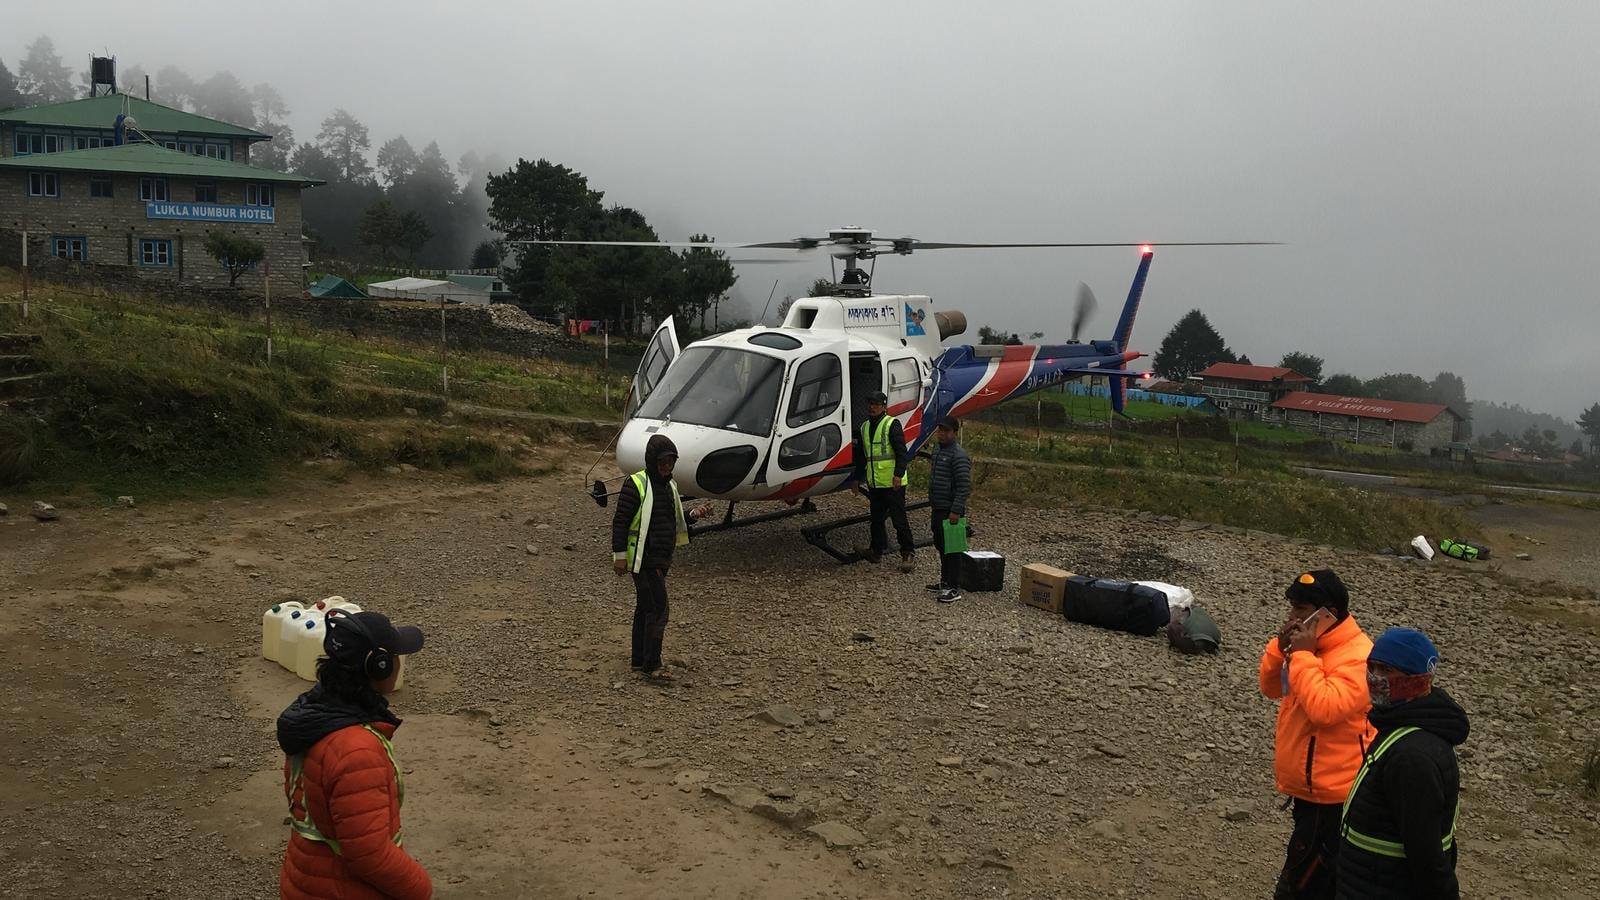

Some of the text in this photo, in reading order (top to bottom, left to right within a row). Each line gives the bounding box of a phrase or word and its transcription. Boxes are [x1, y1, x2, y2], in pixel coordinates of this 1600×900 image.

[155, 205, 273, 220] LUKLA NUMBUR HOTEL
[881, 305, 896, 321] AIR
